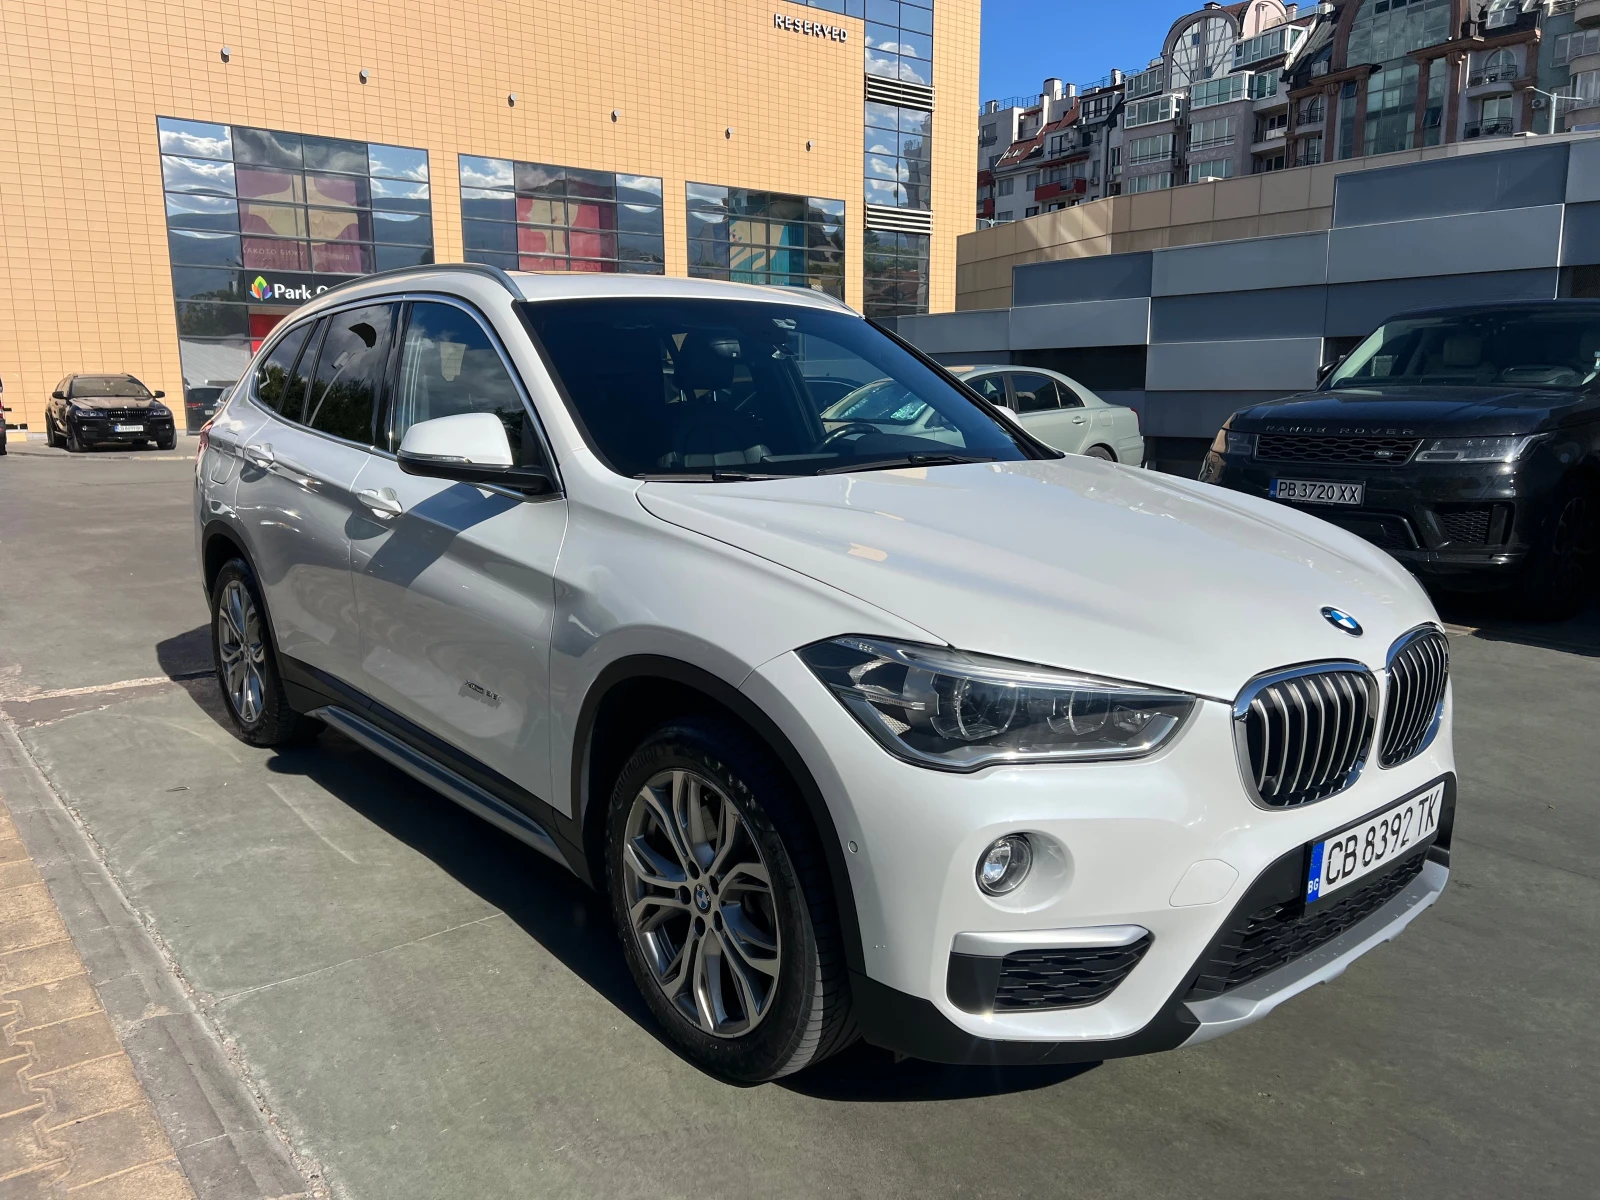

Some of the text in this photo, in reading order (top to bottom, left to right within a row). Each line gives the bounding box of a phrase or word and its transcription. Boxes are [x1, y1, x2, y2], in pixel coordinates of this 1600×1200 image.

[774, 13, 848, 43] RESERVED
[273, 283, 312, 300] Park
[1265, 425, 1327, 433] RANGE
[1278, 482, 1359, 502] PB 3720 XX
[1325, 789, 1441, 886] CB 8392 TK
[1308, 877, 1319, 895] BG
